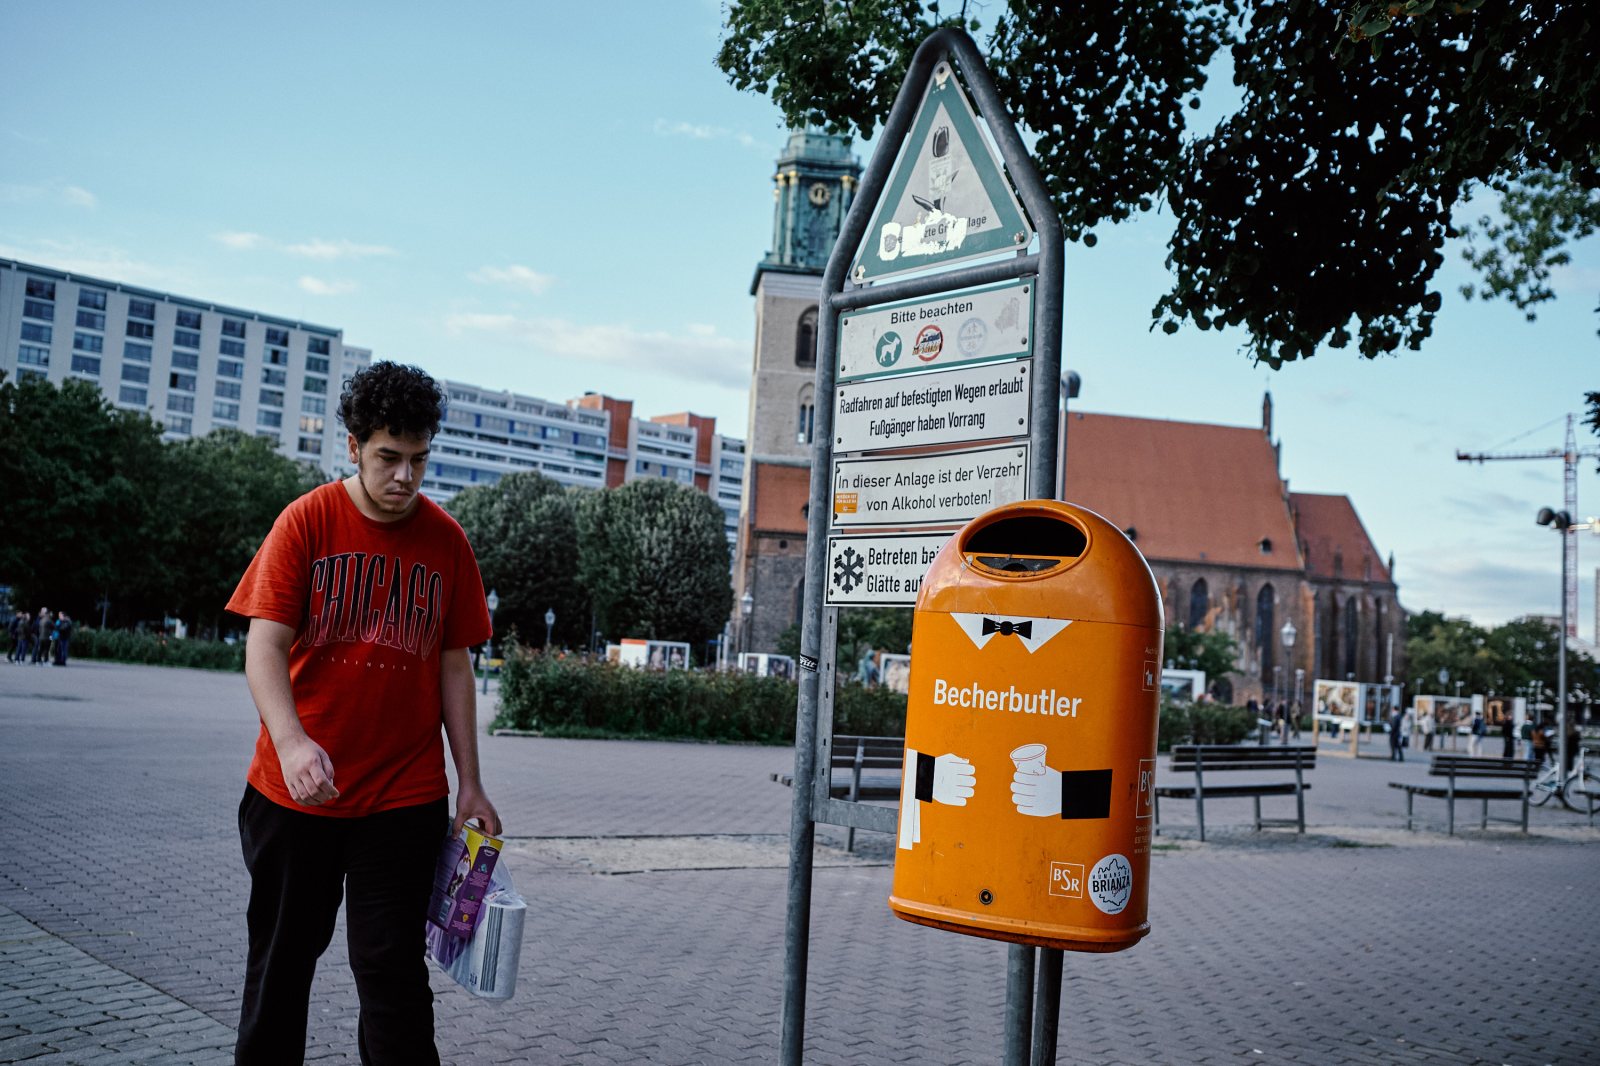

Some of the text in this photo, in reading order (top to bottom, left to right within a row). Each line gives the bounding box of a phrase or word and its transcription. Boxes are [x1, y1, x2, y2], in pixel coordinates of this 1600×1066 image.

[891, 301, 973, 325] Bitte beachten
[840, 376, 1023, 415] Radfahren auf befestigten Wegen erlaubt
[870, 411, 985, 439] Fußgänger haben Vorrang
[838, 461, 1022, 489] In dieser Anlage ist der Verzehr
[866, 489, 992, 511] von Alkohol verboten!
[868, 547, 917, 565] Betreten
[867, 574, 900, 593] Glätte
[300, 552, 443, 662] CHICAGO
[320, 656, 407, 671] ILLINOIS
[933, 678, 1082, 718] Becherbutler
[1053, 868, 1080, 892] BSR
[1092, 875, 1131, 893] BRIANZA
